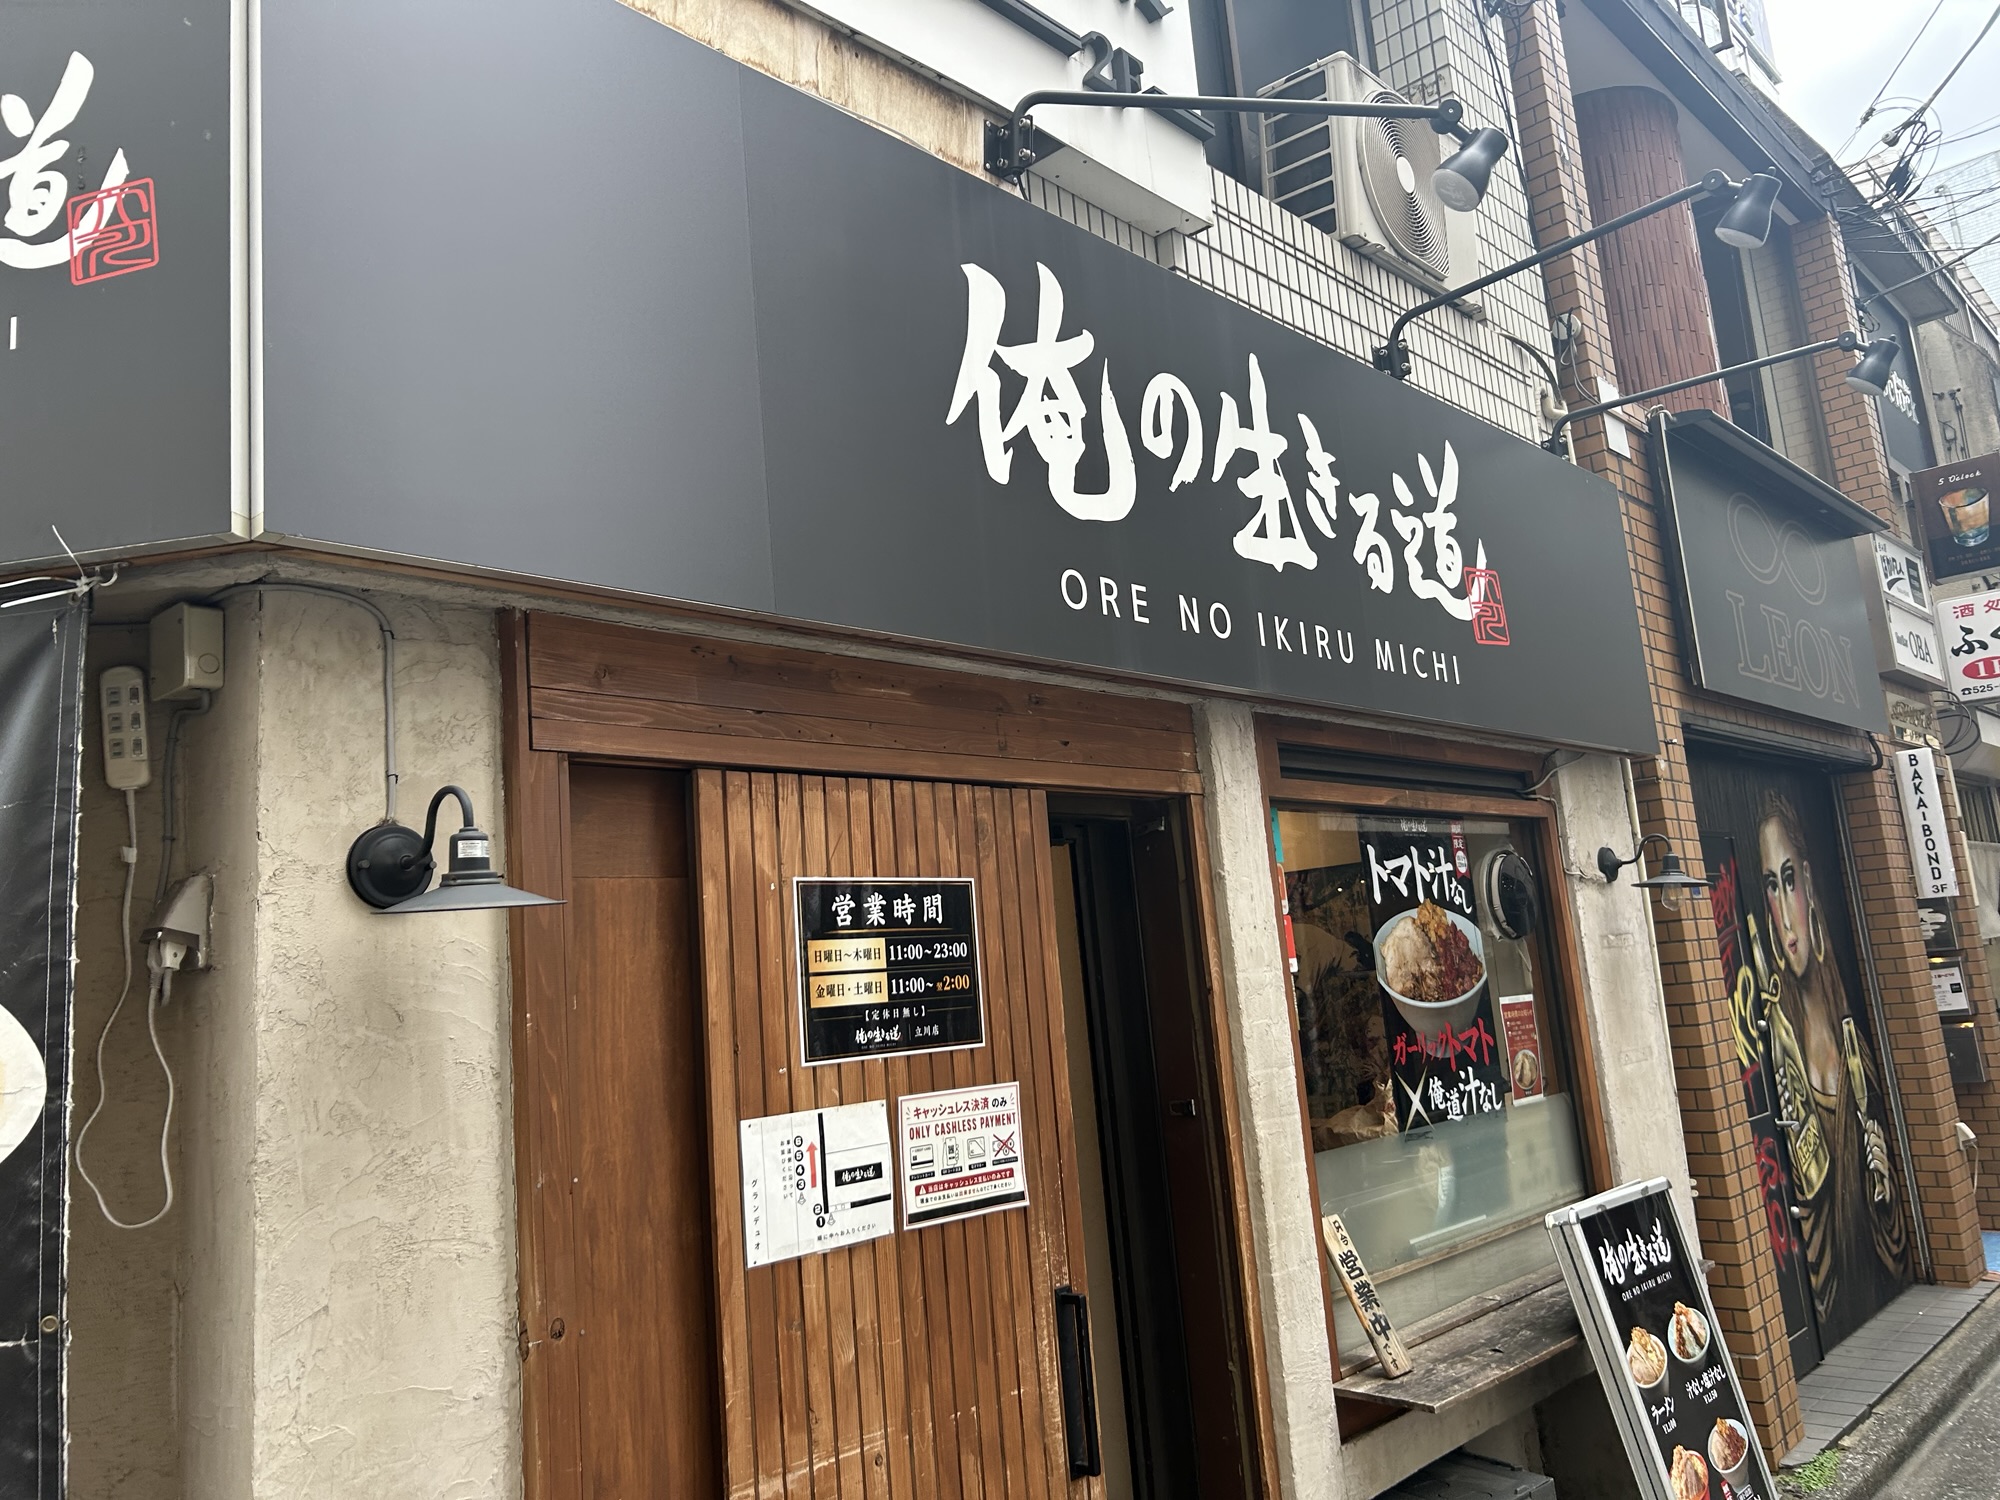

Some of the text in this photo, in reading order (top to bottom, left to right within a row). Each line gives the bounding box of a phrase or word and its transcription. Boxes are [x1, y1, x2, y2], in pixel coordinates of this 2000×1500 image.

[945, 261, 1488, 622] 俺の生きる道
[1060, 569, 1461, 685] ORE NO IKIRU MICHI
[1725, 589, 1860, 710] LEON
[1908, 631, 1934, 664] OBA
[1908, 753, 1942, 880] BAKAIBOND
[1366, 843, 1473, 915] トマト汁なし
[1931, 884, 1948, 894] 3F
[831, 892, 943, 927] 営業時間
[855, 1023, 939, 1044] 俺の生きる道 立川店
[1392, 1017, 1494, 1072] ガーリックトマト
[913, 1096, 1008, 1120] キャッシュレス決済 のみ
[1428, 1066, 1503, 1122] 俺道汁なし
[909, 1112, 1016, 1140] ONLY CASHLESS PAYMENT
[751, 1178, 761, 1250] グランデュオ
[1598, 1217, 1672, 1286] 俺の生きる道
[1622, 1271, 1672, 1302] ORE NO IKIRU MICHI
[1650, 1396, 1675, 1426] ラーメン
